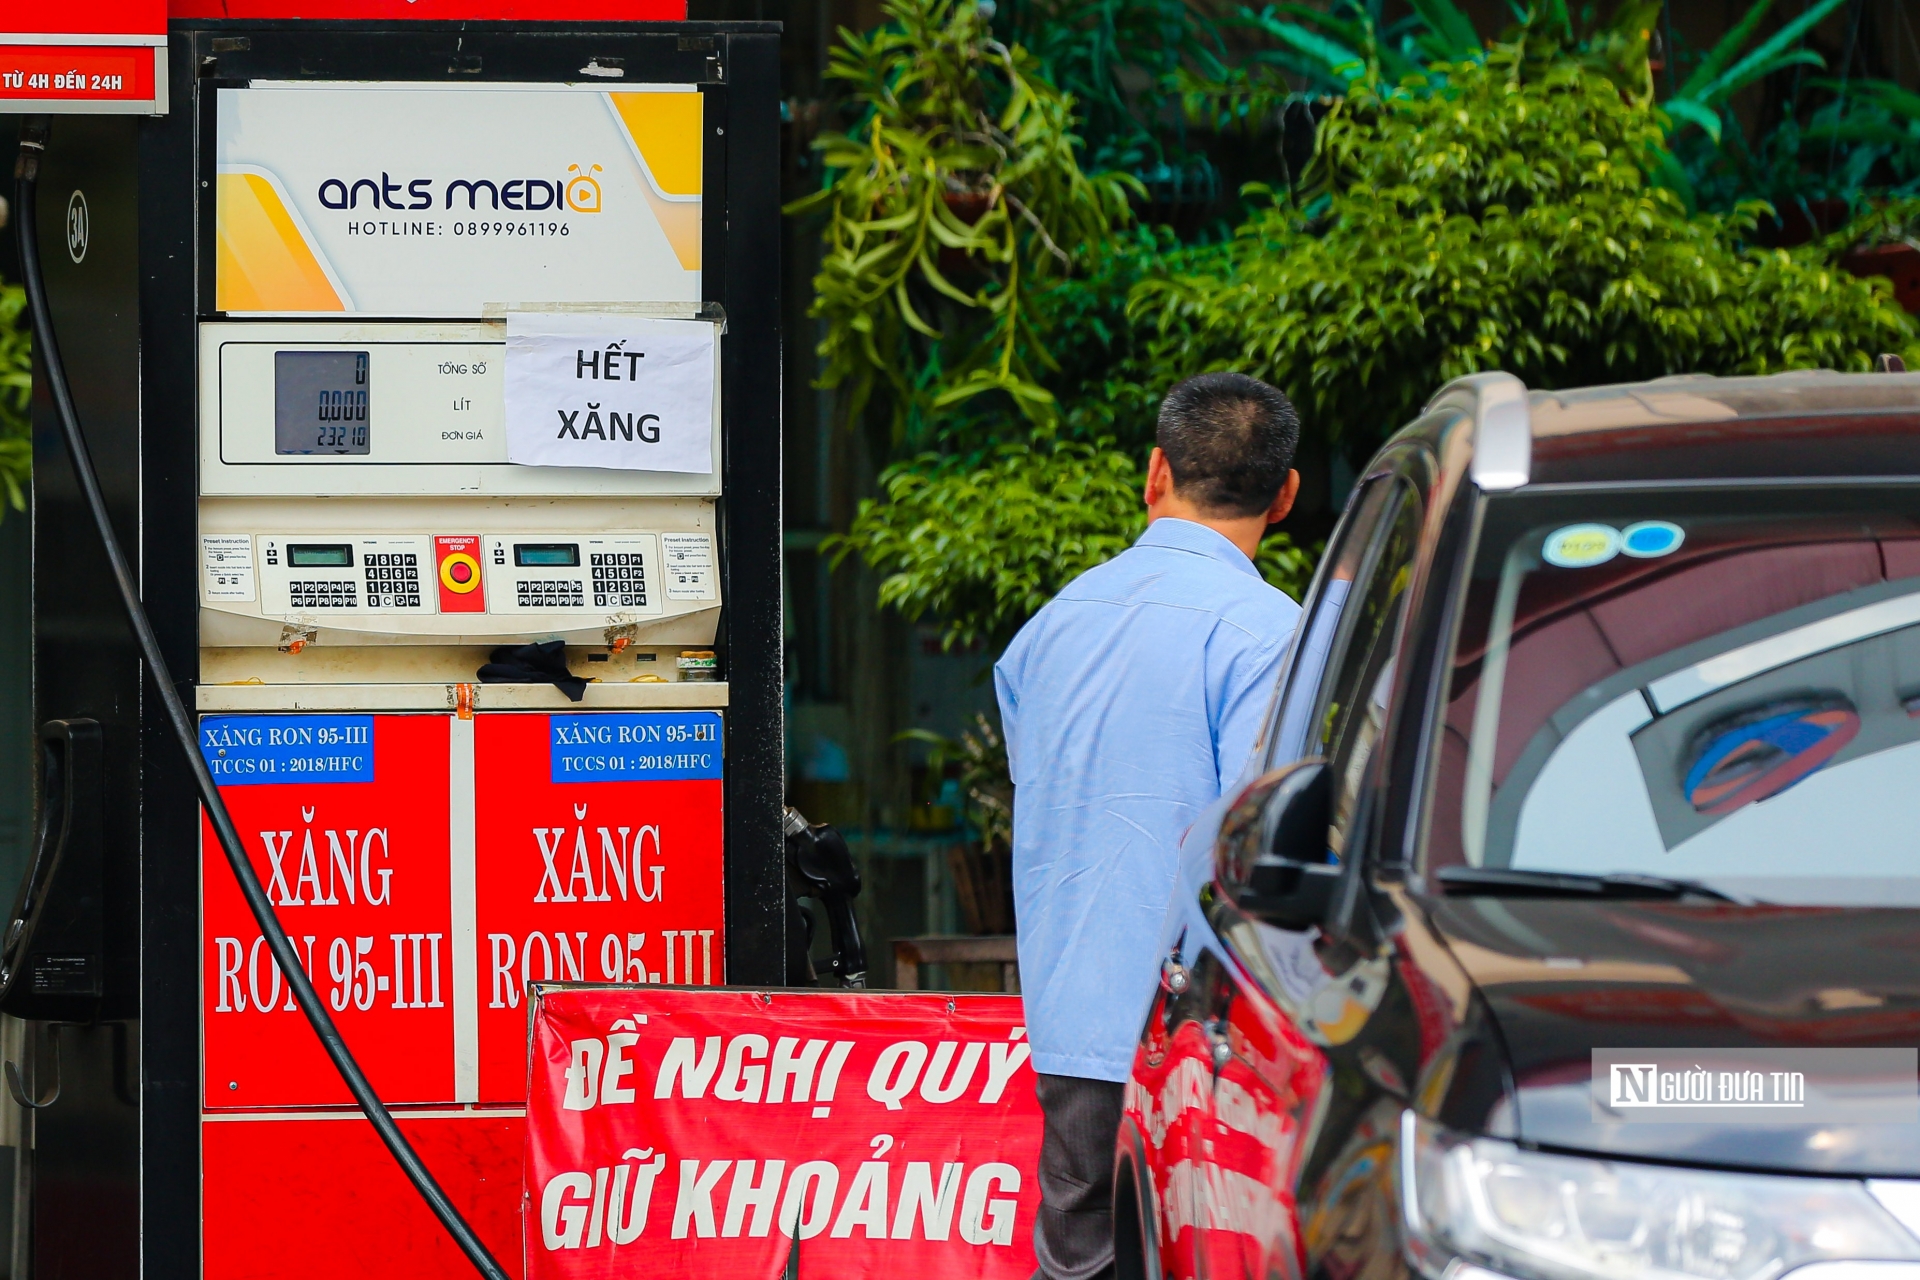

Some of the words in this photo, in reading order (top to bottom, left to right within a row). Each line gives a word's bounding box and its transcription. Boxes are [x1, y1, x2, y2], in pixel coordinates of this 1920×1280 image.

[3, 70, 23, 88] TỪ
[28, 73, 49, 89] 4H
[54, 69, 85, 90] ĐẾN
[91, 75, 122, 90] 24H
[318, 171, 433, 210] ants
[70, 206, 85, 250] 3A
[348, 221, 443, 236] HOTLINE:
[453, 221, 570, 236] 0899961196
[438, 360, 468, 375] TỔNG
[471, 360, 487, 375] SỐ
[576, 339, 645, 382] HẾT
[355, 354, 366, 385] 0
[453, 399, 471, 412] LÍT
[557, 402, 661, 444] XĂNG
[441, 429, 464, 440] ĐƠN
[466, 429, 484, 440] GIÁ
[366, 556, 373, 565] 7
[380, 556, 387, 565] 8
[394, 556, 400, 565] 9
[593, 555, 600, 564] 7
[606, 555, 613, 564] 8
[620, 555, 627, 564] 9
[368, 569, 375, 578] 4
[381, 569, 388, 578] 5
[395, 569, 402, 578] 6
[594, 569, 601, 578] 4
[608, 569, 615, 578] 5
[621, 569, 628, 578] 6
[291, 583, 300, 591] P1
[304, 583, 315, 591] P2
[318, 583, 328, 591] P3
[331, 583, 341, 591] P4
[345, 583, 355, 591] P5
[370, 583, 375, 592] 1
[382, 583, 389, 592] 2
[396, 583, 403, 592] 3
[518, 583, 527, 591] P1
[531, 583, 541, 591] P2
[544, 583, 555, 591] P3
[558, 583, 568, 591] P4
[571, 583, 581, 591] P5
[596, 582, 601, 591] 1
[609, 582, 616, 591] 2
[622, 582, 629, 591] 3
[292, 597, 302, 605] P6
[306, 597, 315, 605] P7
[319, 597, 329, 605] P8
[332, 597, 342, 605] P9
[345, 597, 356, 605] P10
[370, 596, 377, 605] 0
[383, 596, 390, 605] C
[597, 596, 603, 605] 0
[610, 596, 617, 605] C
[205, 723, 262, 747] XĂNG
[268, 726, 314, 746] RON
[318, 726, 368, 745] 95-III
[555, 722, 614, 746] XĂNG
[618, 725, 664, 744] RON
[668, 723, 716, 743] 95-III
[211, 759, 257, 775] TCCS
[259, 758, 277, 773] 01
[289, 756, 363, 773] 2018/HFC
[562, 756, 607, 772] TCCS
[609, 755, 627, 771] 01
[639, 753, 711, 771] 2018/HFC
[260, 805, 393, 907] XĂNG
[533, 802, 665, 903] XĂNG
[329, 932, 444, 1013] 95-III
[562, 1013, 648, 1111] ĐỀ
[653, 1033, 855, 1119] NGHỊ
[866, 1026, 1031, 1110] QUÝ
[541, 1146, 666, 1251] GIỮ
[670, 1133, 1022, 1246] KHOẢNG
